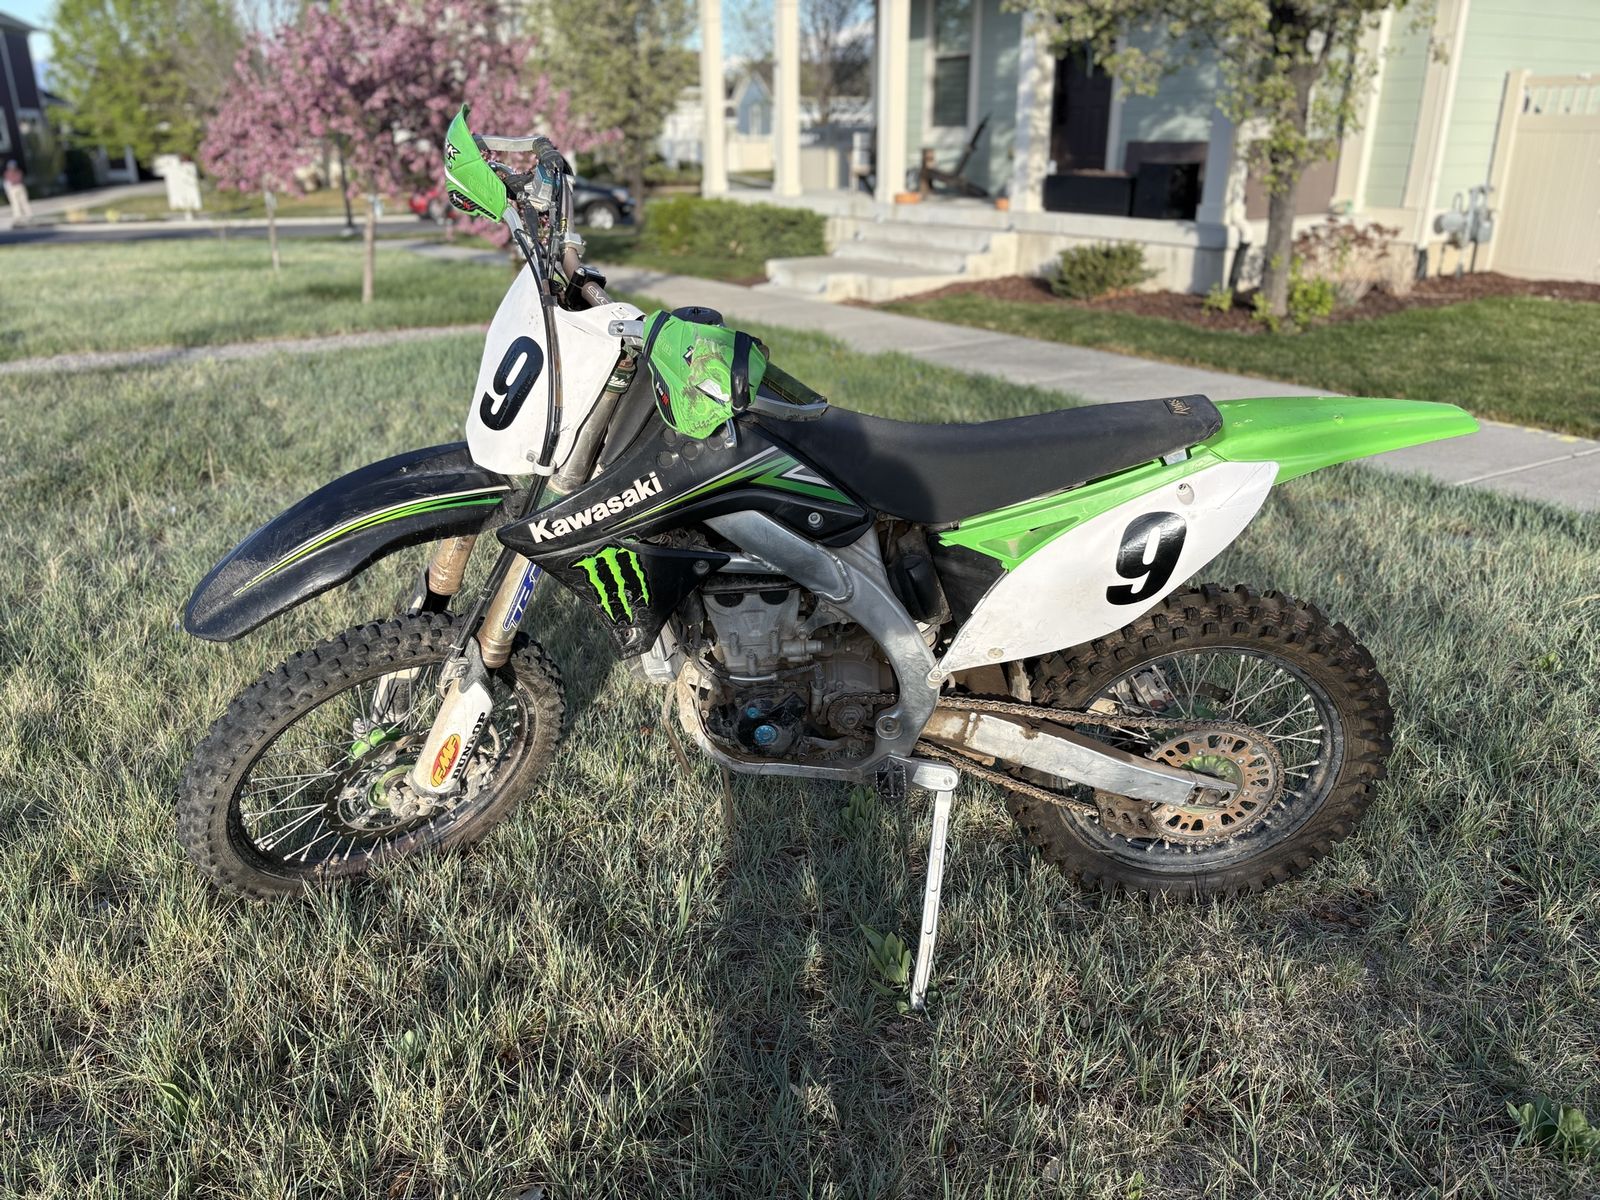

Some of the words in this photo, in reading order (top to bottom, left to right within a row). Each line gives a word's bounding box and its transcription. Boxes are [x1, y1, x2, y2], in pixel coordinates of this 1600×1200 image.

[479, 335, 544, 431] 9
[528, 471, 663, 544] Kawasaki
[1106, 511, 1187, 605] 9
[432, 734, 459, 786] FMF
